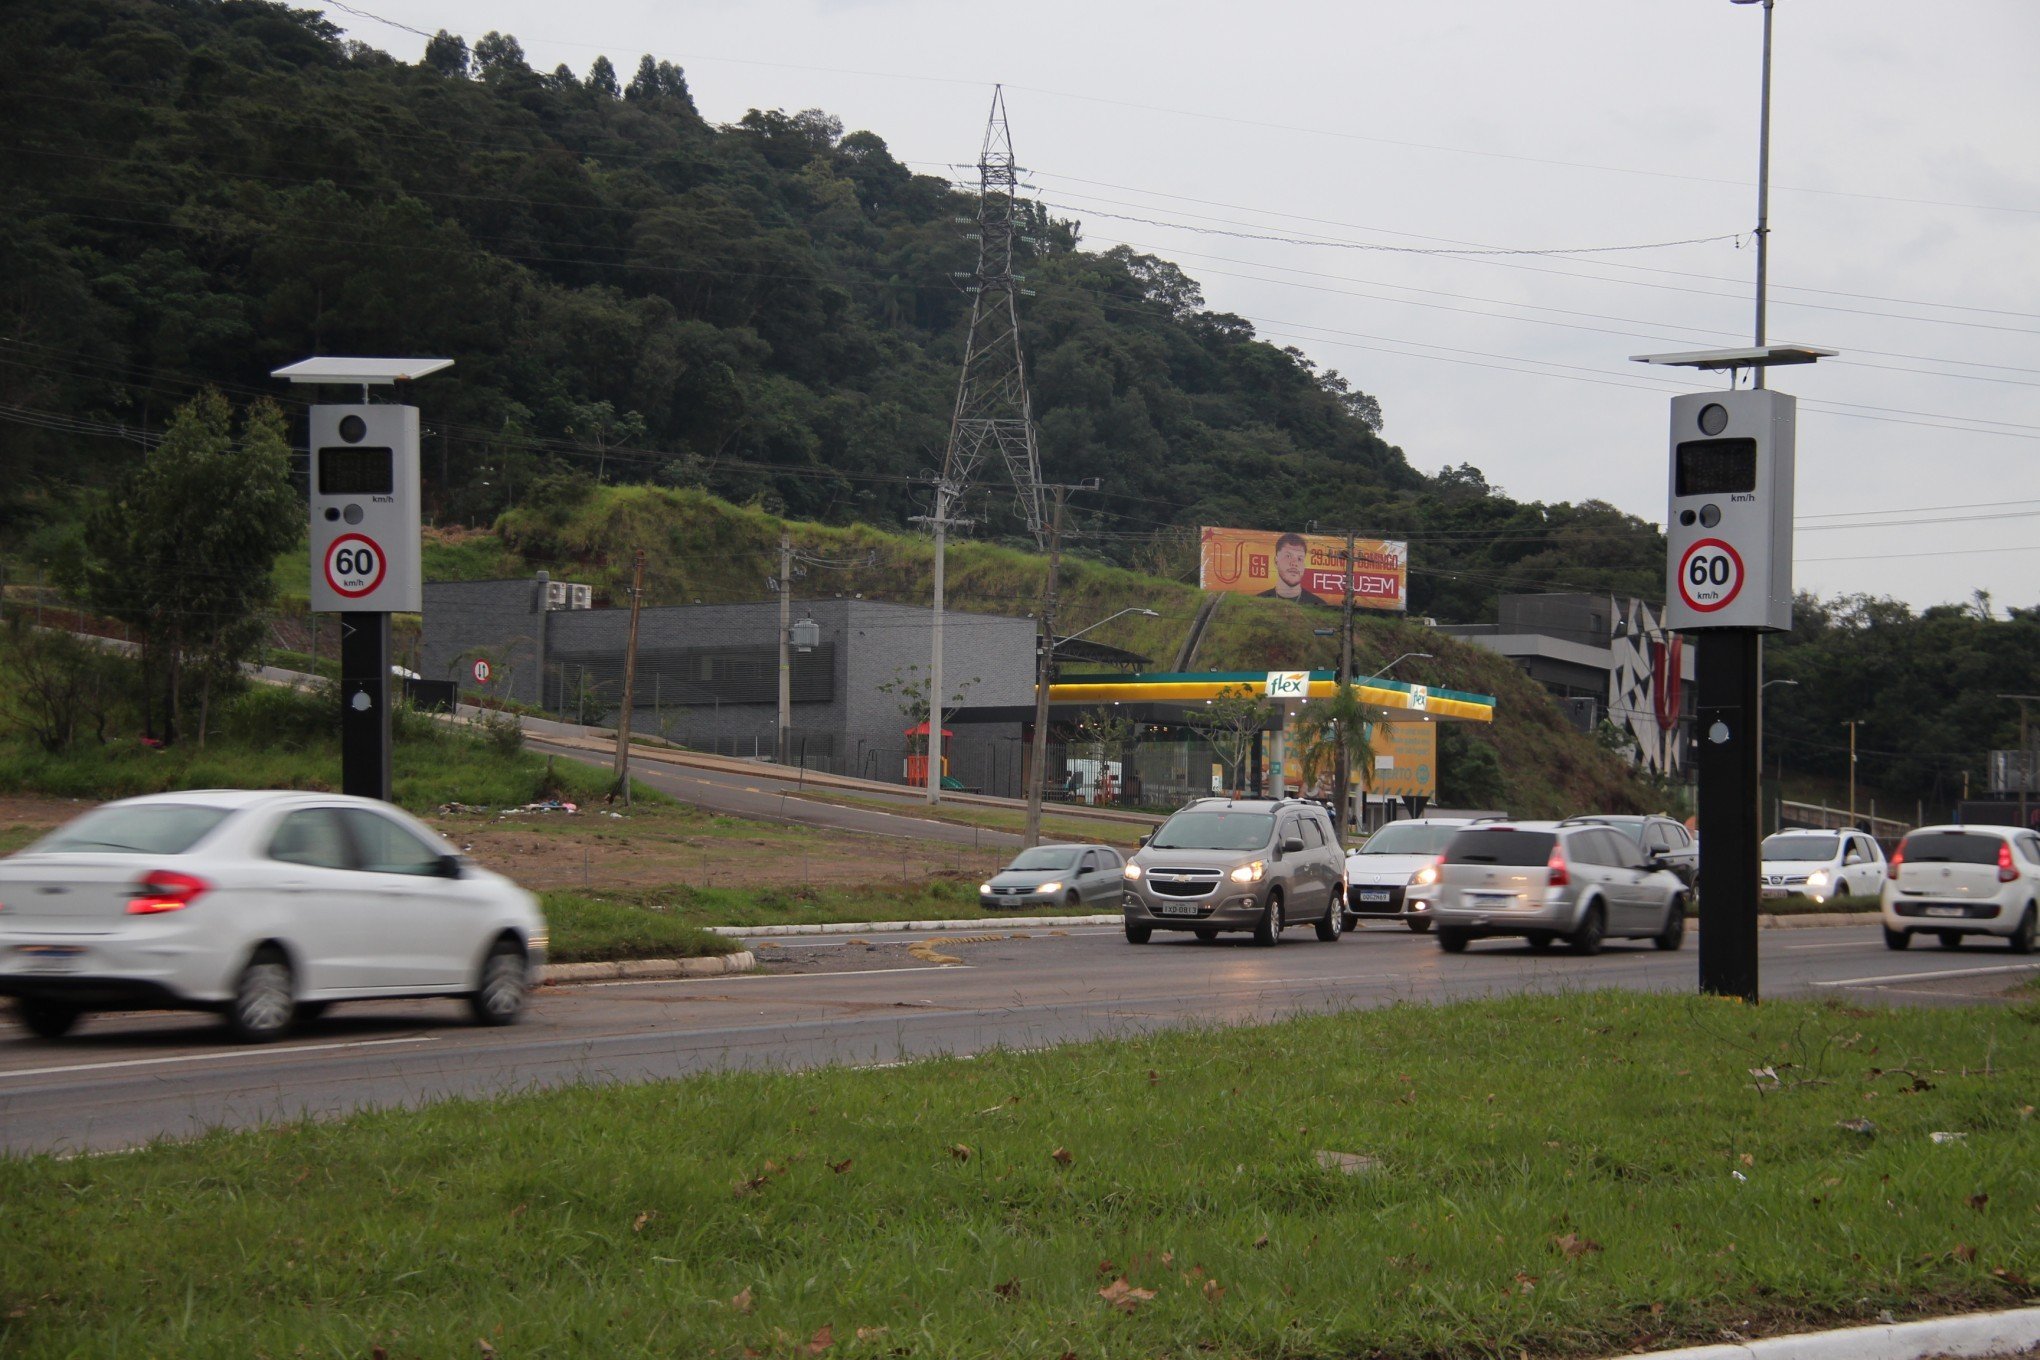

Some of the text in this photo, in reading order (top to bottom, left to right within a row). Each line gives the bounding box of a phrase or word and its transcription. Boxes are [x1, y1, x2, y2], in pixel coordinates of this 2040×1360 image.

[372, 495, 394, 503] km/h
[1731, 494, 1755, 502] km/h
[336, 548, 374, 576] 60
[1689, 555, 1730, 586] 60
[344, 579, 364, 587] km/h
[1697, 591, 1719, 600] km/h
[1271, 673, 1301, 695] flex
